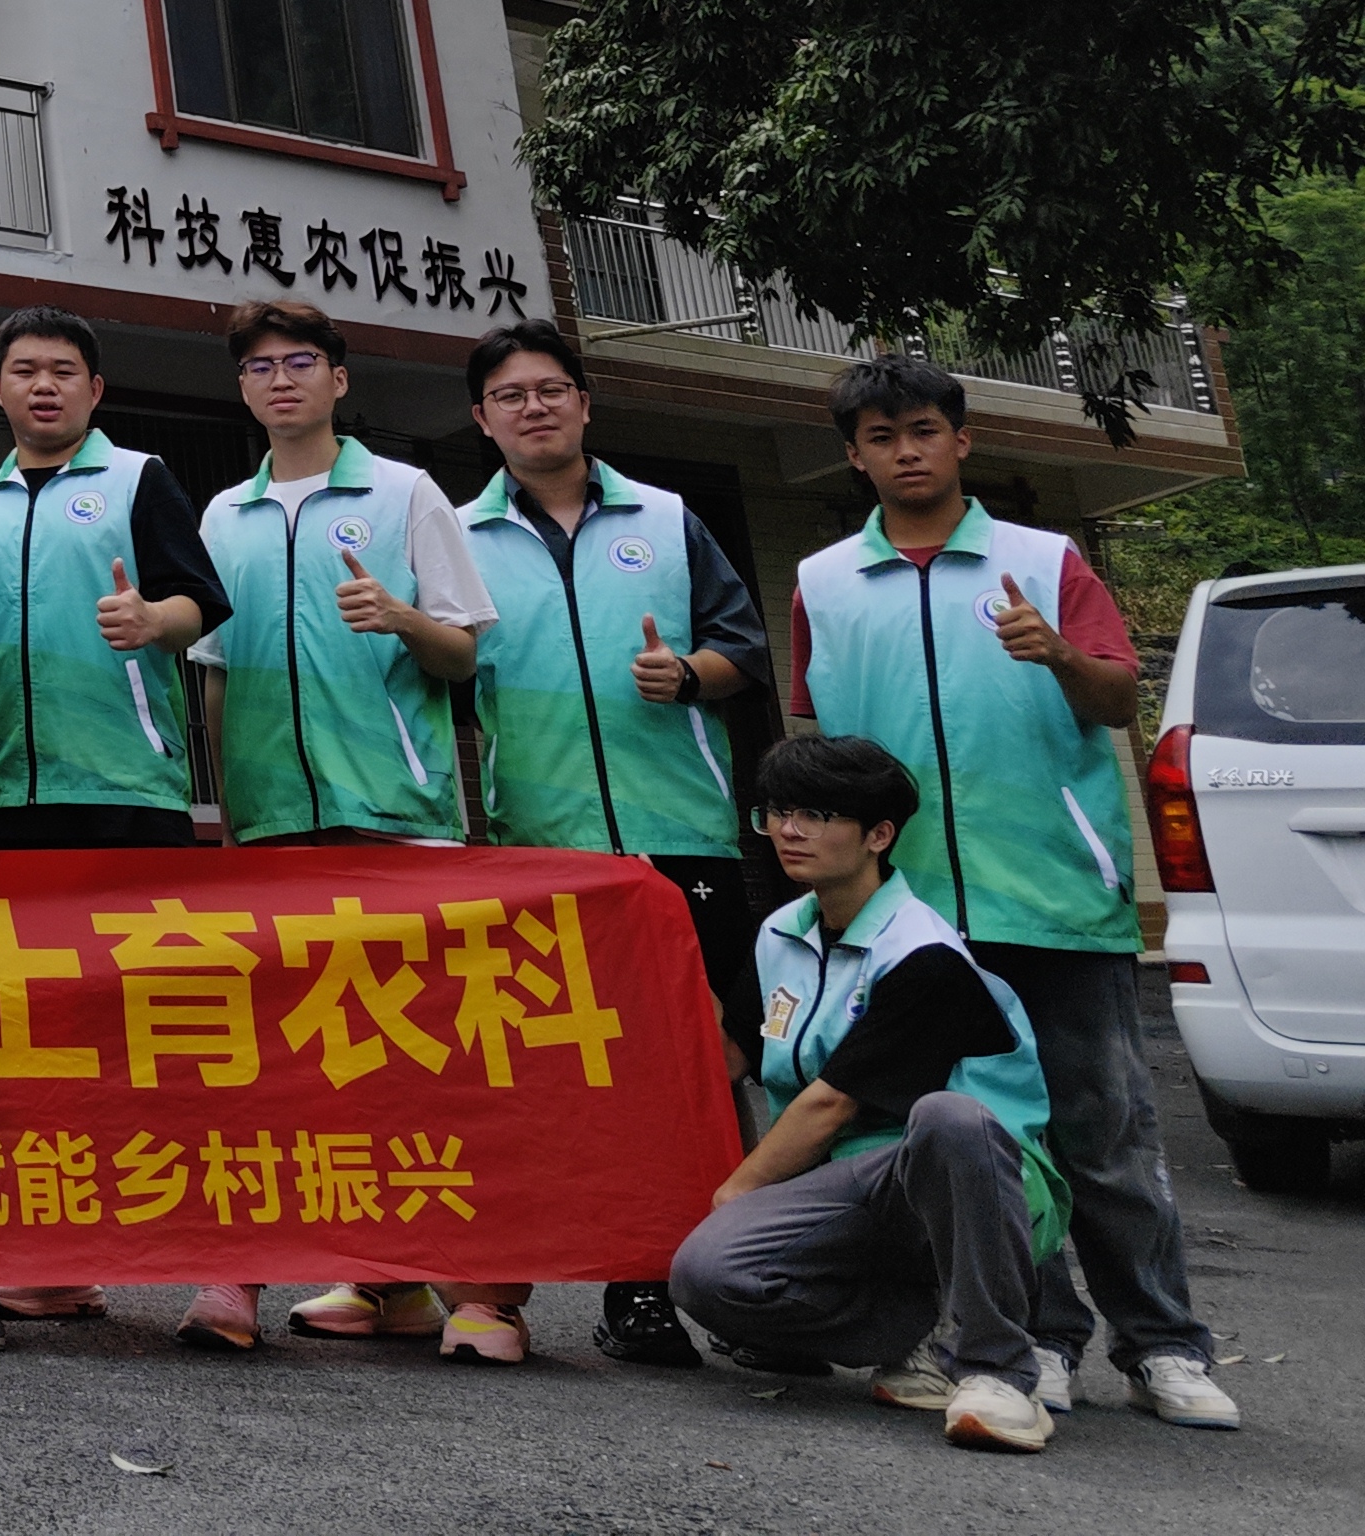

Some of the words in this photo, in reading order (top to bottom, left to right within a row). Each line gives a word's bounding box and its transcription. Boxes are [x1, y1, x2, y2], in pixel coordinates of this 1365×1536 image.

[104, 185, 528, 320] 科技惠农促振兴
